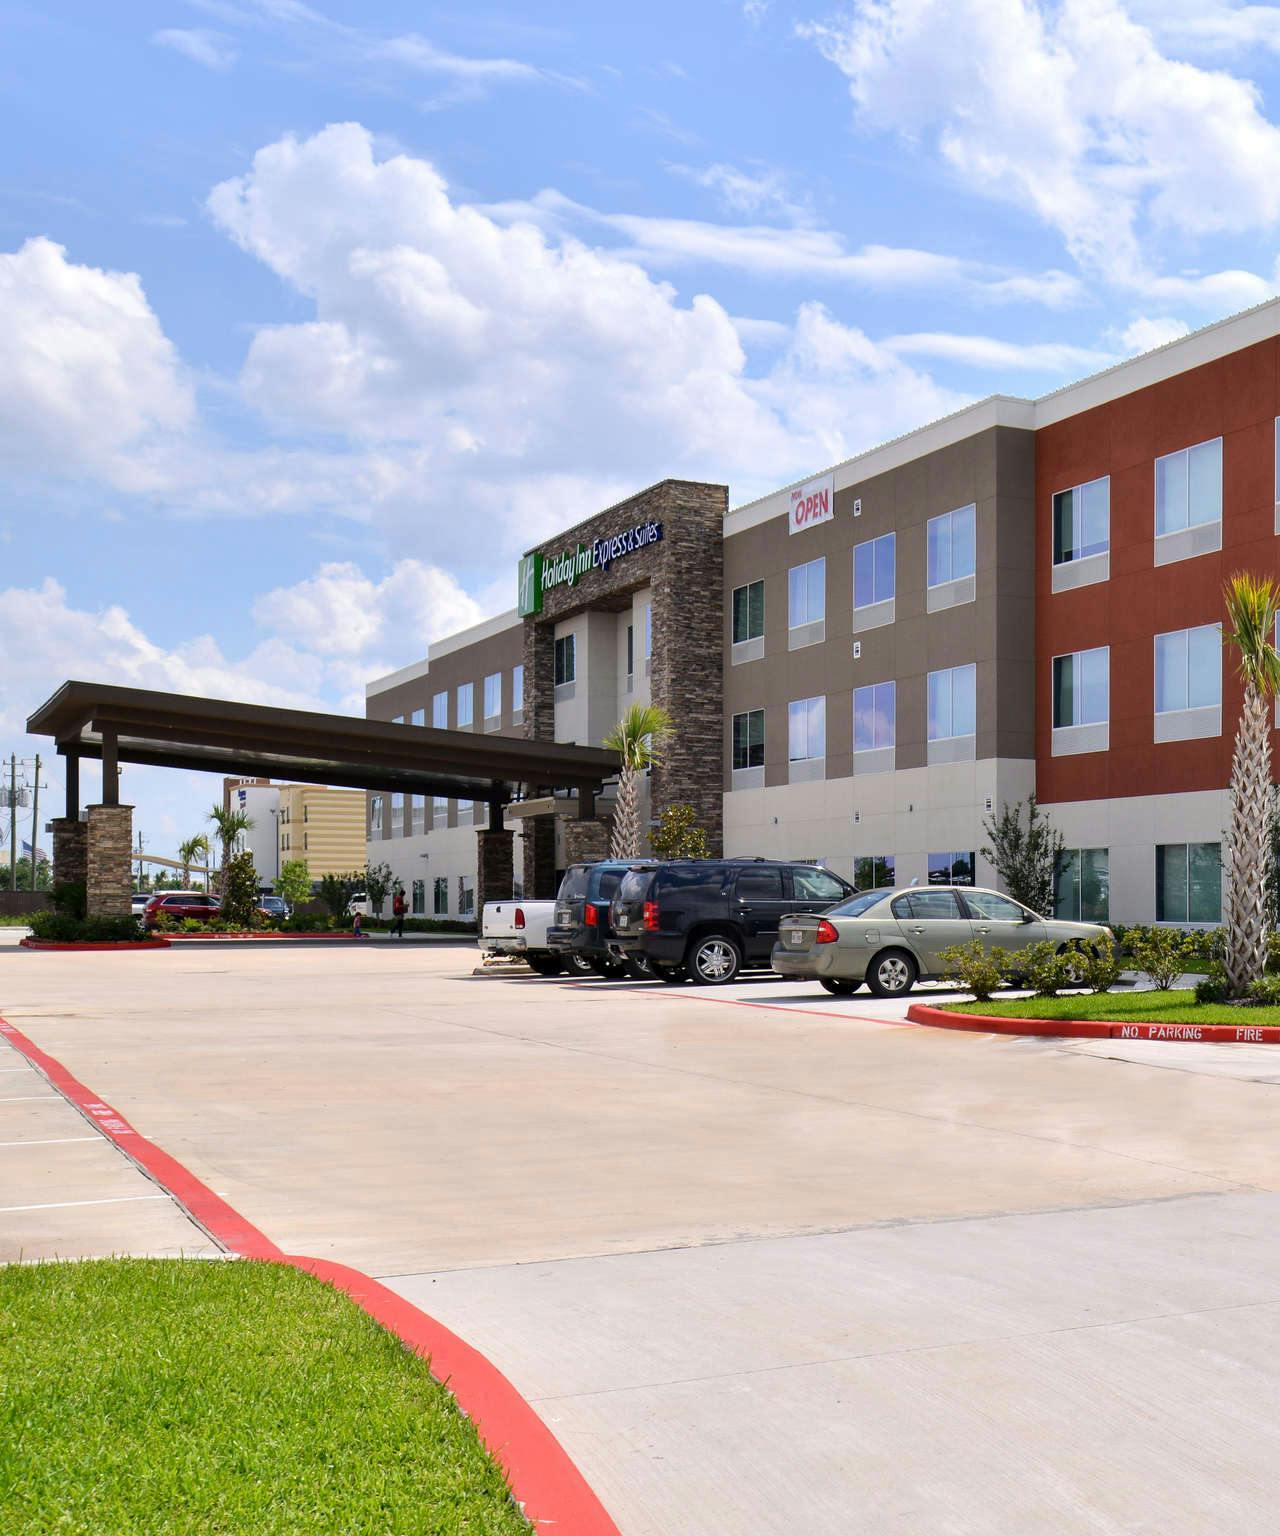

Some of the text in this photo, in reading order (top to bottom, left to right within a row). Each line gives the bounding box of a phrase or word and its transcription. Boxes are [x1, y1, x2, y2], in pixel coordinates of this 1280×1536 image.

[795, 488, 829, 526] OPEN
[541, 520, 659, 591] Holiday Inn Express & Suites
[1121, 1026, 1139, 1038] NO
[1148, 1026, 1202, 1039] PARKING
[1235, 1028, 1264, 1041] FIRE
